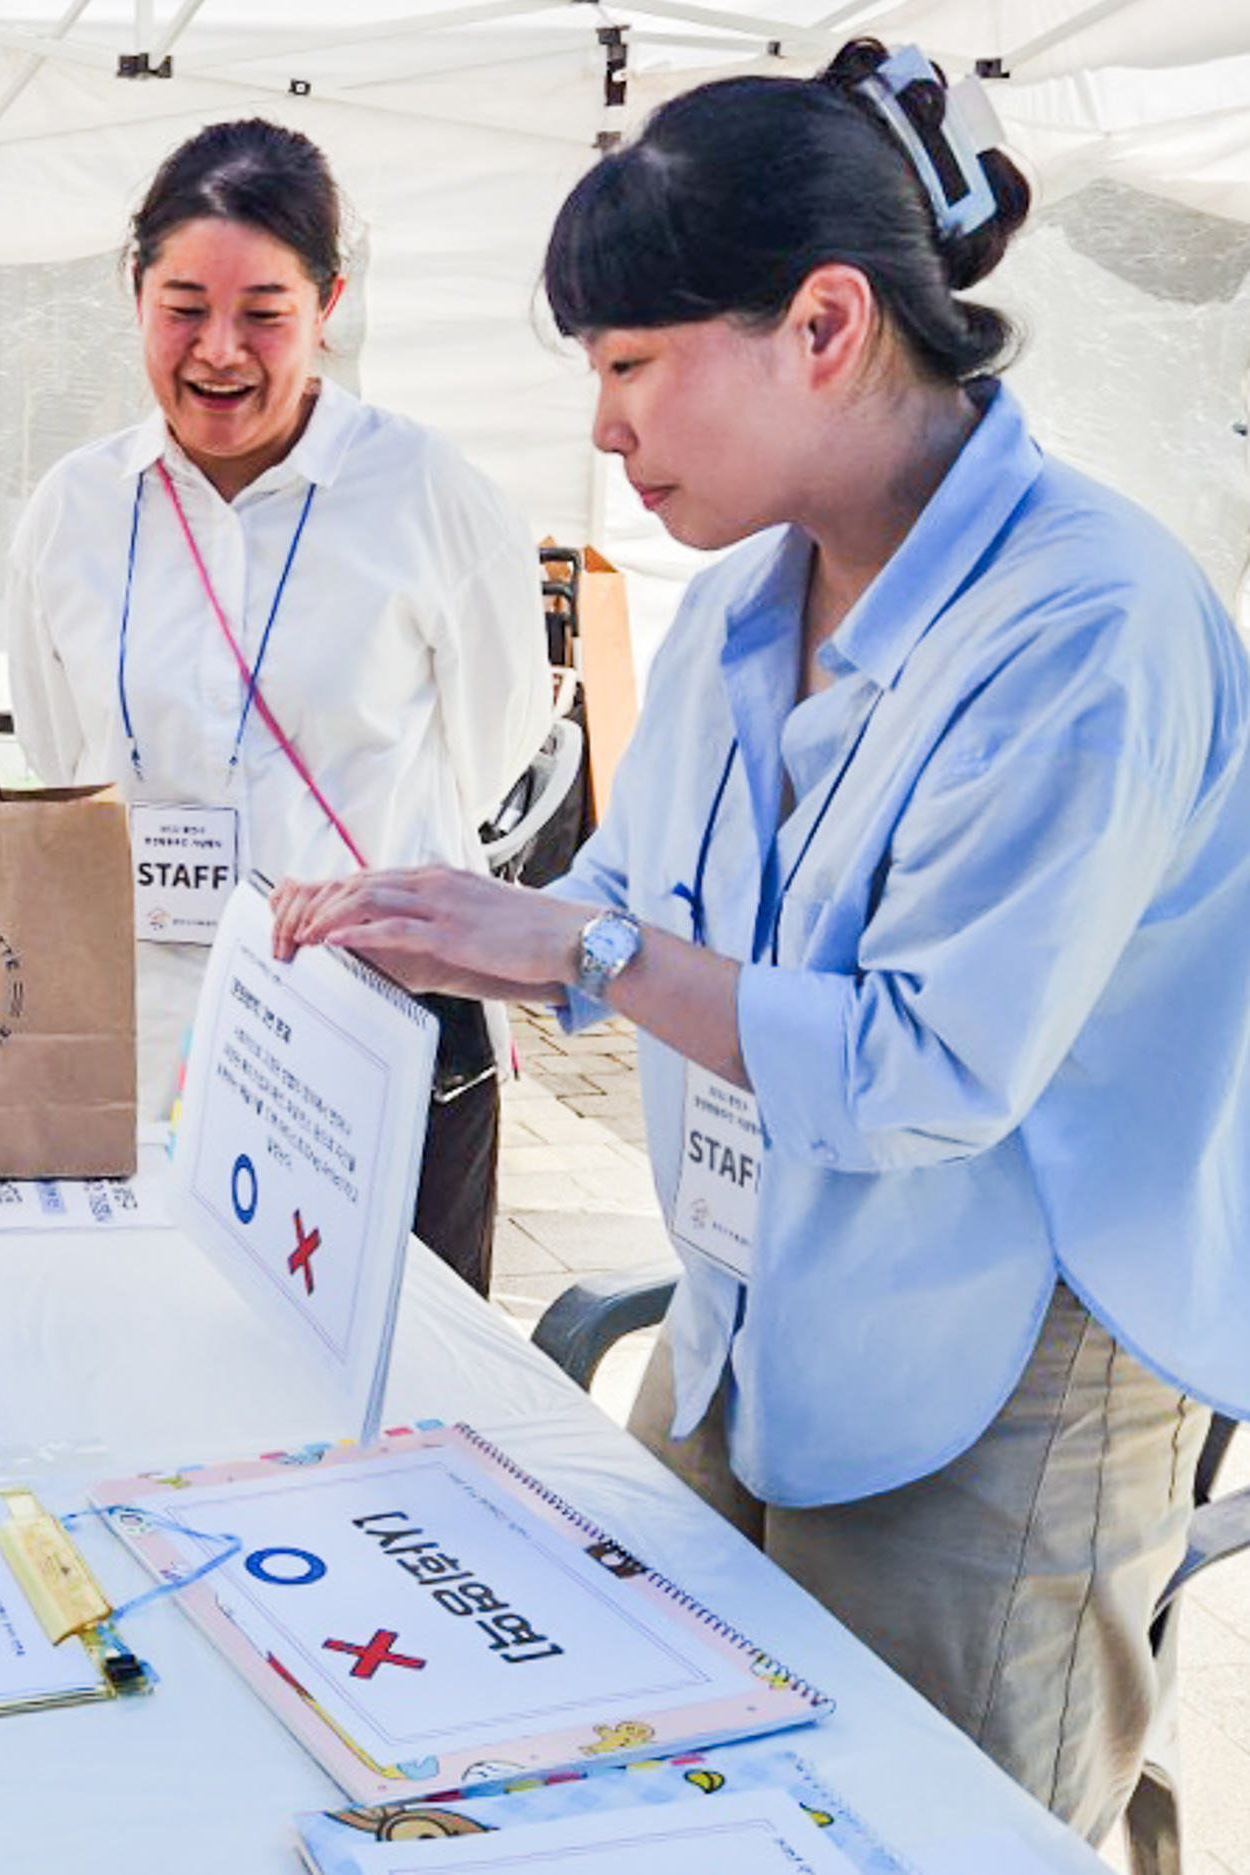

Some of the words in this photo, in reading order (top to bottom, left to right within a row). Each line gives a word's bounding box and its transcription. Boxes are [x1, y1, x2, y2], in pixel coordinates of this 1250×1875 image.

[137, 863, 229, 889] STAFF
[688, 1130, 761, 1194] STAF
[351, 1510, 564, 1665] [사회영역]
